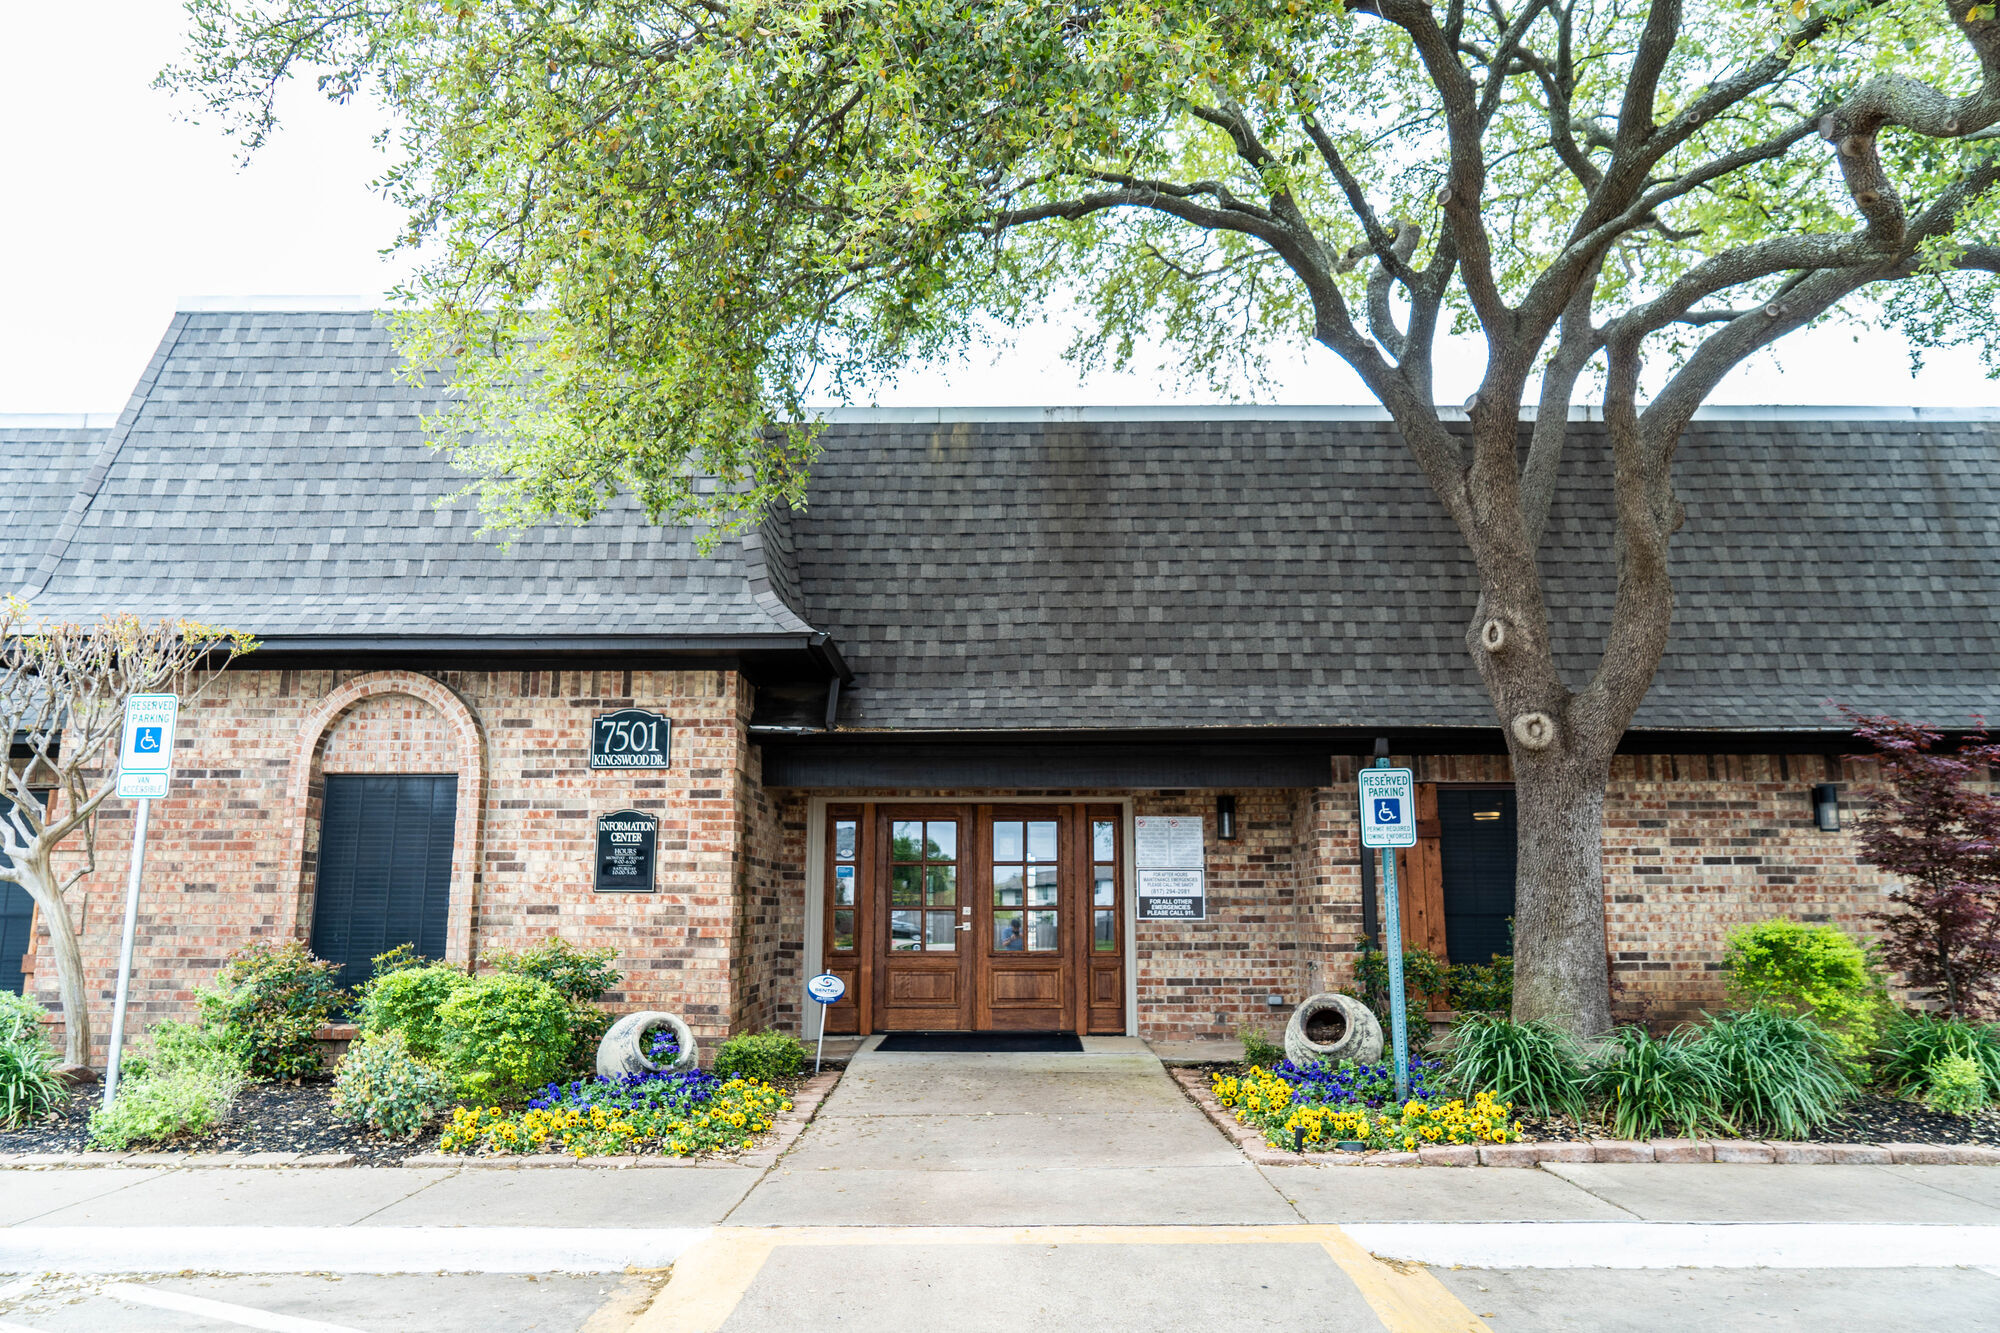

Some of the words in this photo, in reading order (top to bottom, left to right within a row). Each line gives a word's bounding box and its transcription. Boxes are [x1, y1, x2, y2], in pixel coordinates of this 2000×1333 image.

[131, 701, 174, 710] RESERVED
[132, 714, 170, 723] PARKING
[601, 720, 660, 753] 7501
[594, 754, 650, 766] KINGSWOOD
[650, 754, 666, 766] DR.
[1364, 776, 1408, 786] RESERVED
[122, 785, 162, 793] ACCESSIBLE
[1368, 787, 1404, 797] PARKING
[600, 822, 655, 831] INFORMATION
[610, 832, 642, 842] CENTER
